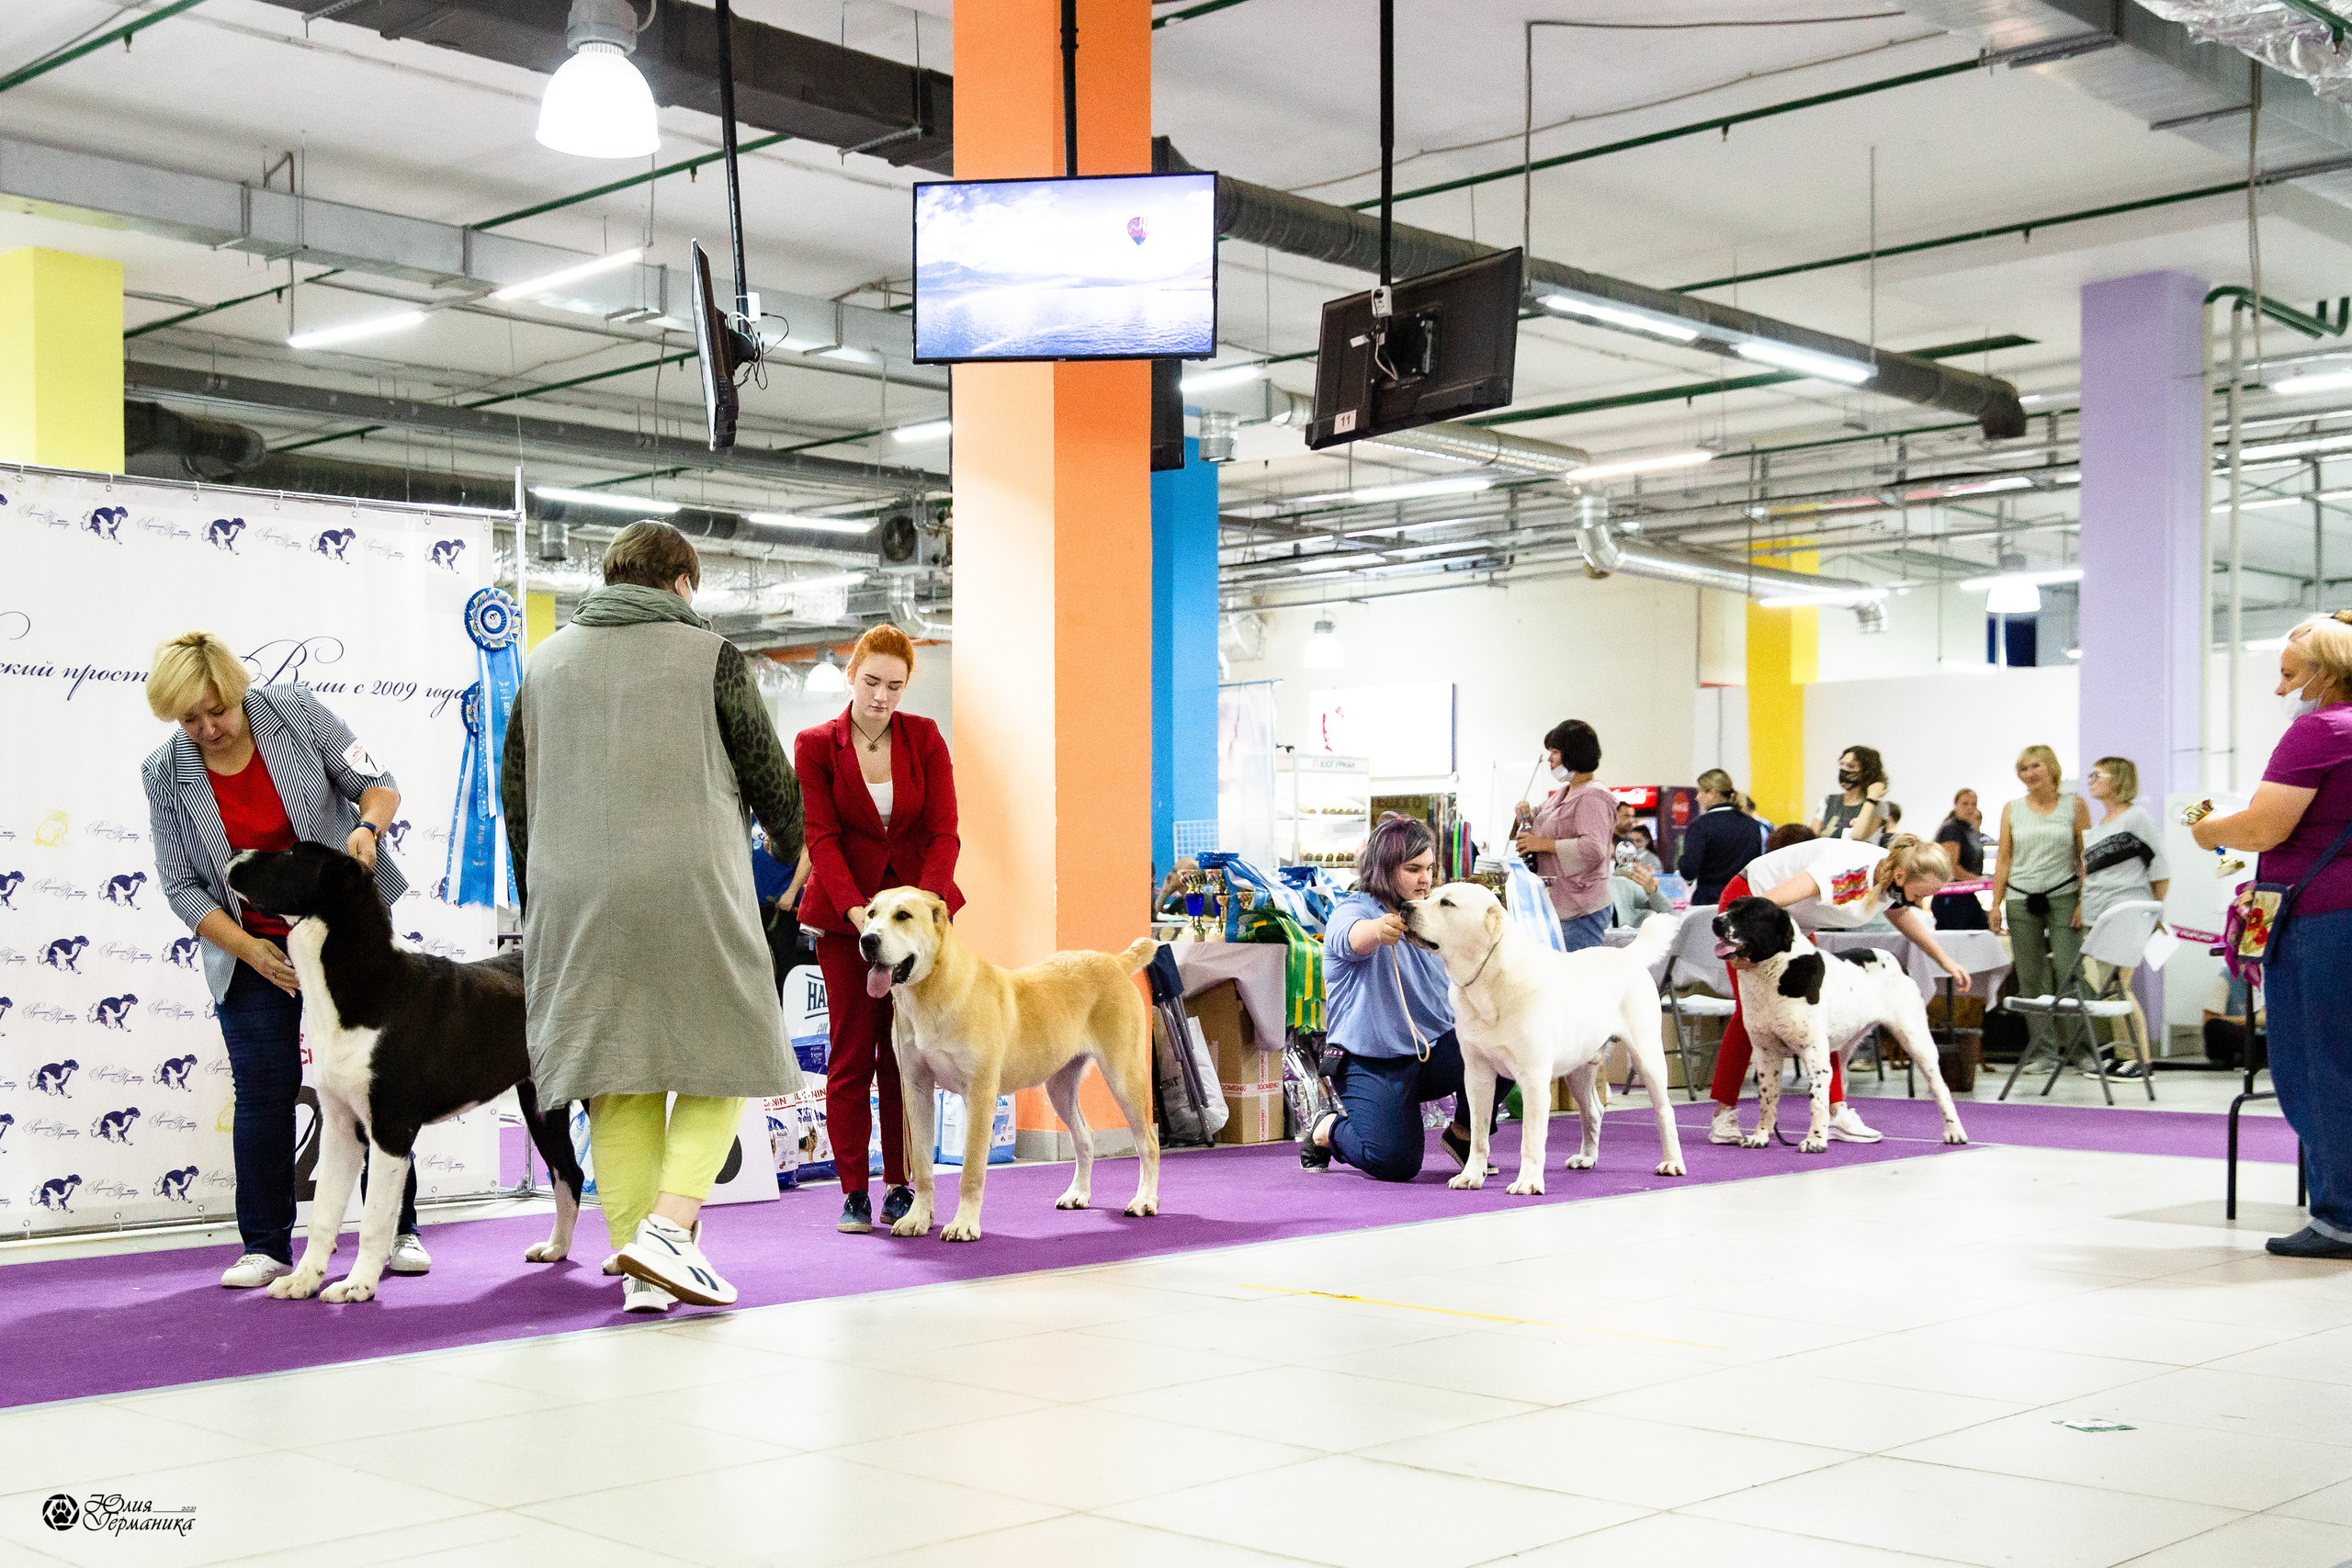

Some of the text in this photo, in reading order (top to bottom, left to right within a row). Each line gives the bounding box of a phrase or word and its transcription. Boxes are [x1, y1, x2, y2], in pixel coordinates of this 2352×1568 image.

[1341, 415, 1351, 426] 11
[62, 663, 149, 701] прост
[354, 683, 365, 694] с
[369, 680, 418, 702] 2009
[424, 687, 465, 718] года
[807, 981, 828, 1011] HA
